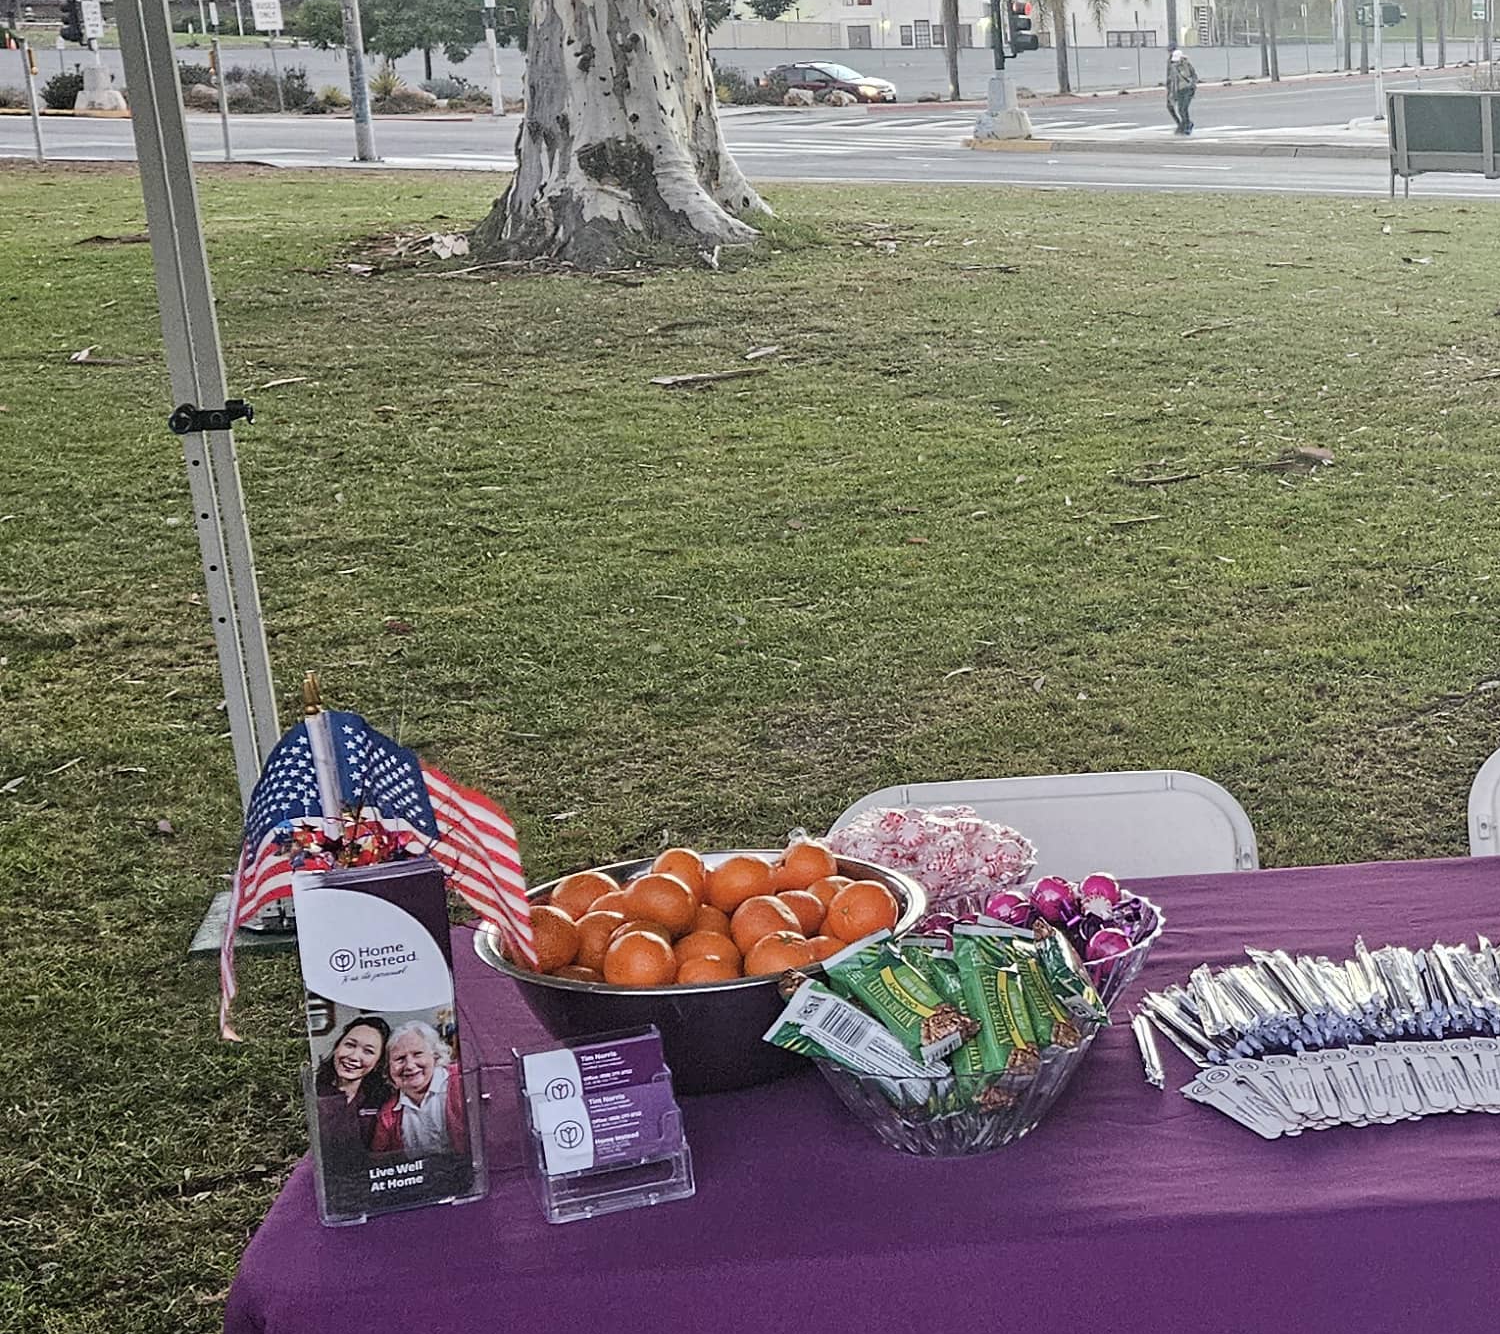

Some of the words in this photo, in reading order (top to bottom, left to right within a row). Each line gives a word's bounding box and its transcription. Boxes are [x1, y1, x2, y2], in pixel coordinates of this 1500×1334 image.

[359, 943, 404, 958] Home
[360, 951, 417, 969] Instead
[369, 1167, 395, 1179] Live
[395, 1159, 424, 1174] Well
[370, 1181, 386, 1193] At
[387, 1175, 424, 1189] Home
